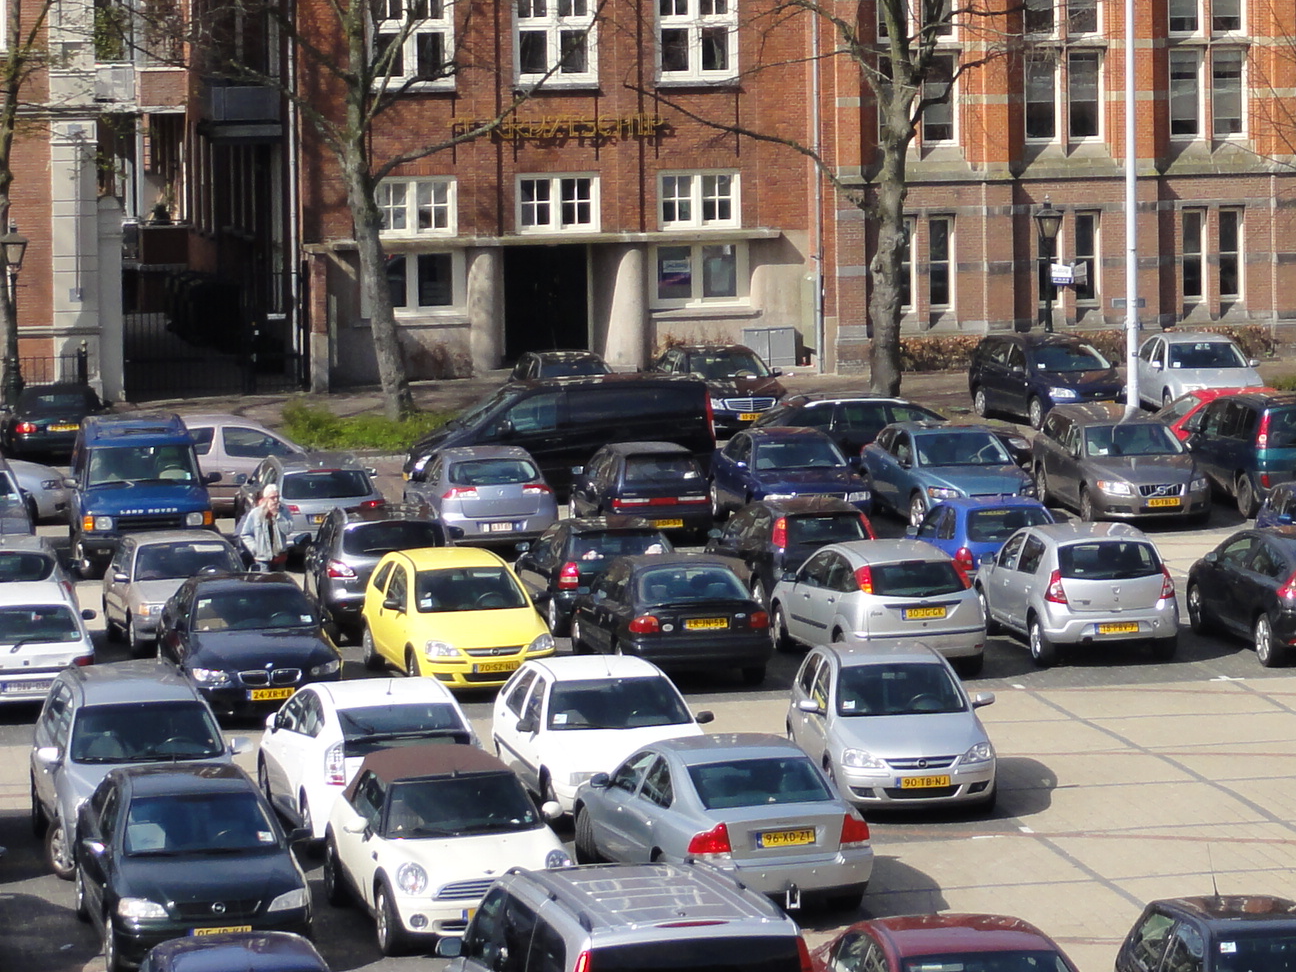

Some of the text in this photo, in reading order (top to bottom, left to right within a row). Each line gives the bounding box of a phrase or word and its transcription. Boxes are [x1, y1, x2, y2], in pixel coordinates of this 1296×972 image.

[479, 661, 515, 673] 70-SZ-NL
[904, 778, 947, 788] 90-TB-NJ
[766, 831, 811, 844] 96-XD-ZT
